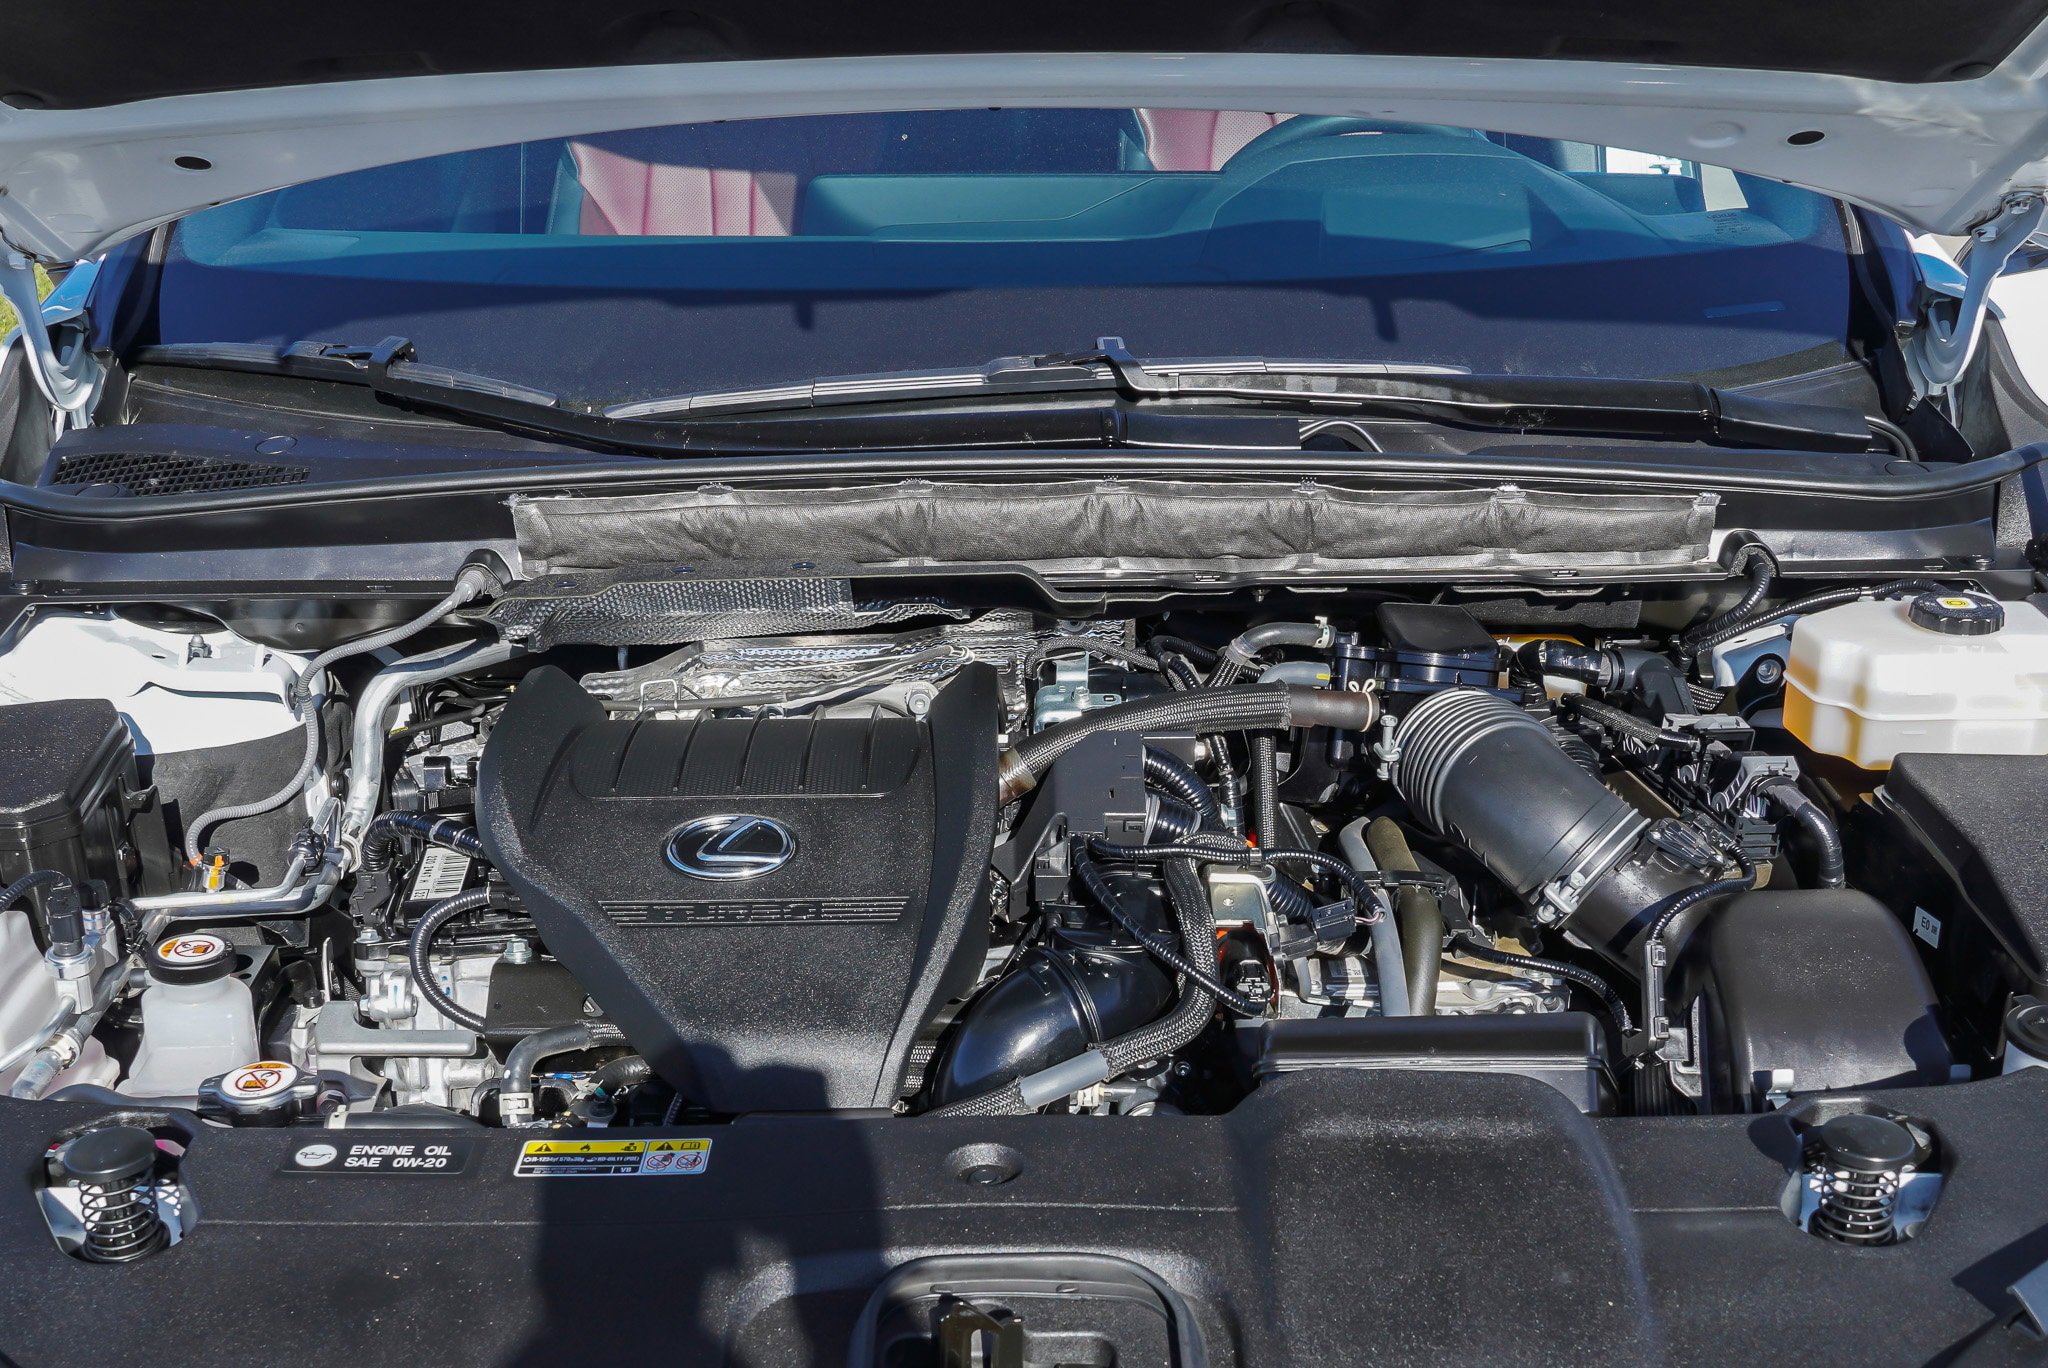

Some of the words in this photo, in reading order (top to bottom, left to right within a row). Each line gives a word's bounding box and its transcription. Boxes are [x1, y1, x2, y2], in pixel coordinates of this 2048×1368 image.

[350, 1145, 415, 1156] ENGINE
[424, 1145, 452, 1156] OIL
[344, 1157, 382, 1168] SAE
[392, 1157, 447, 1168] 0W-20
